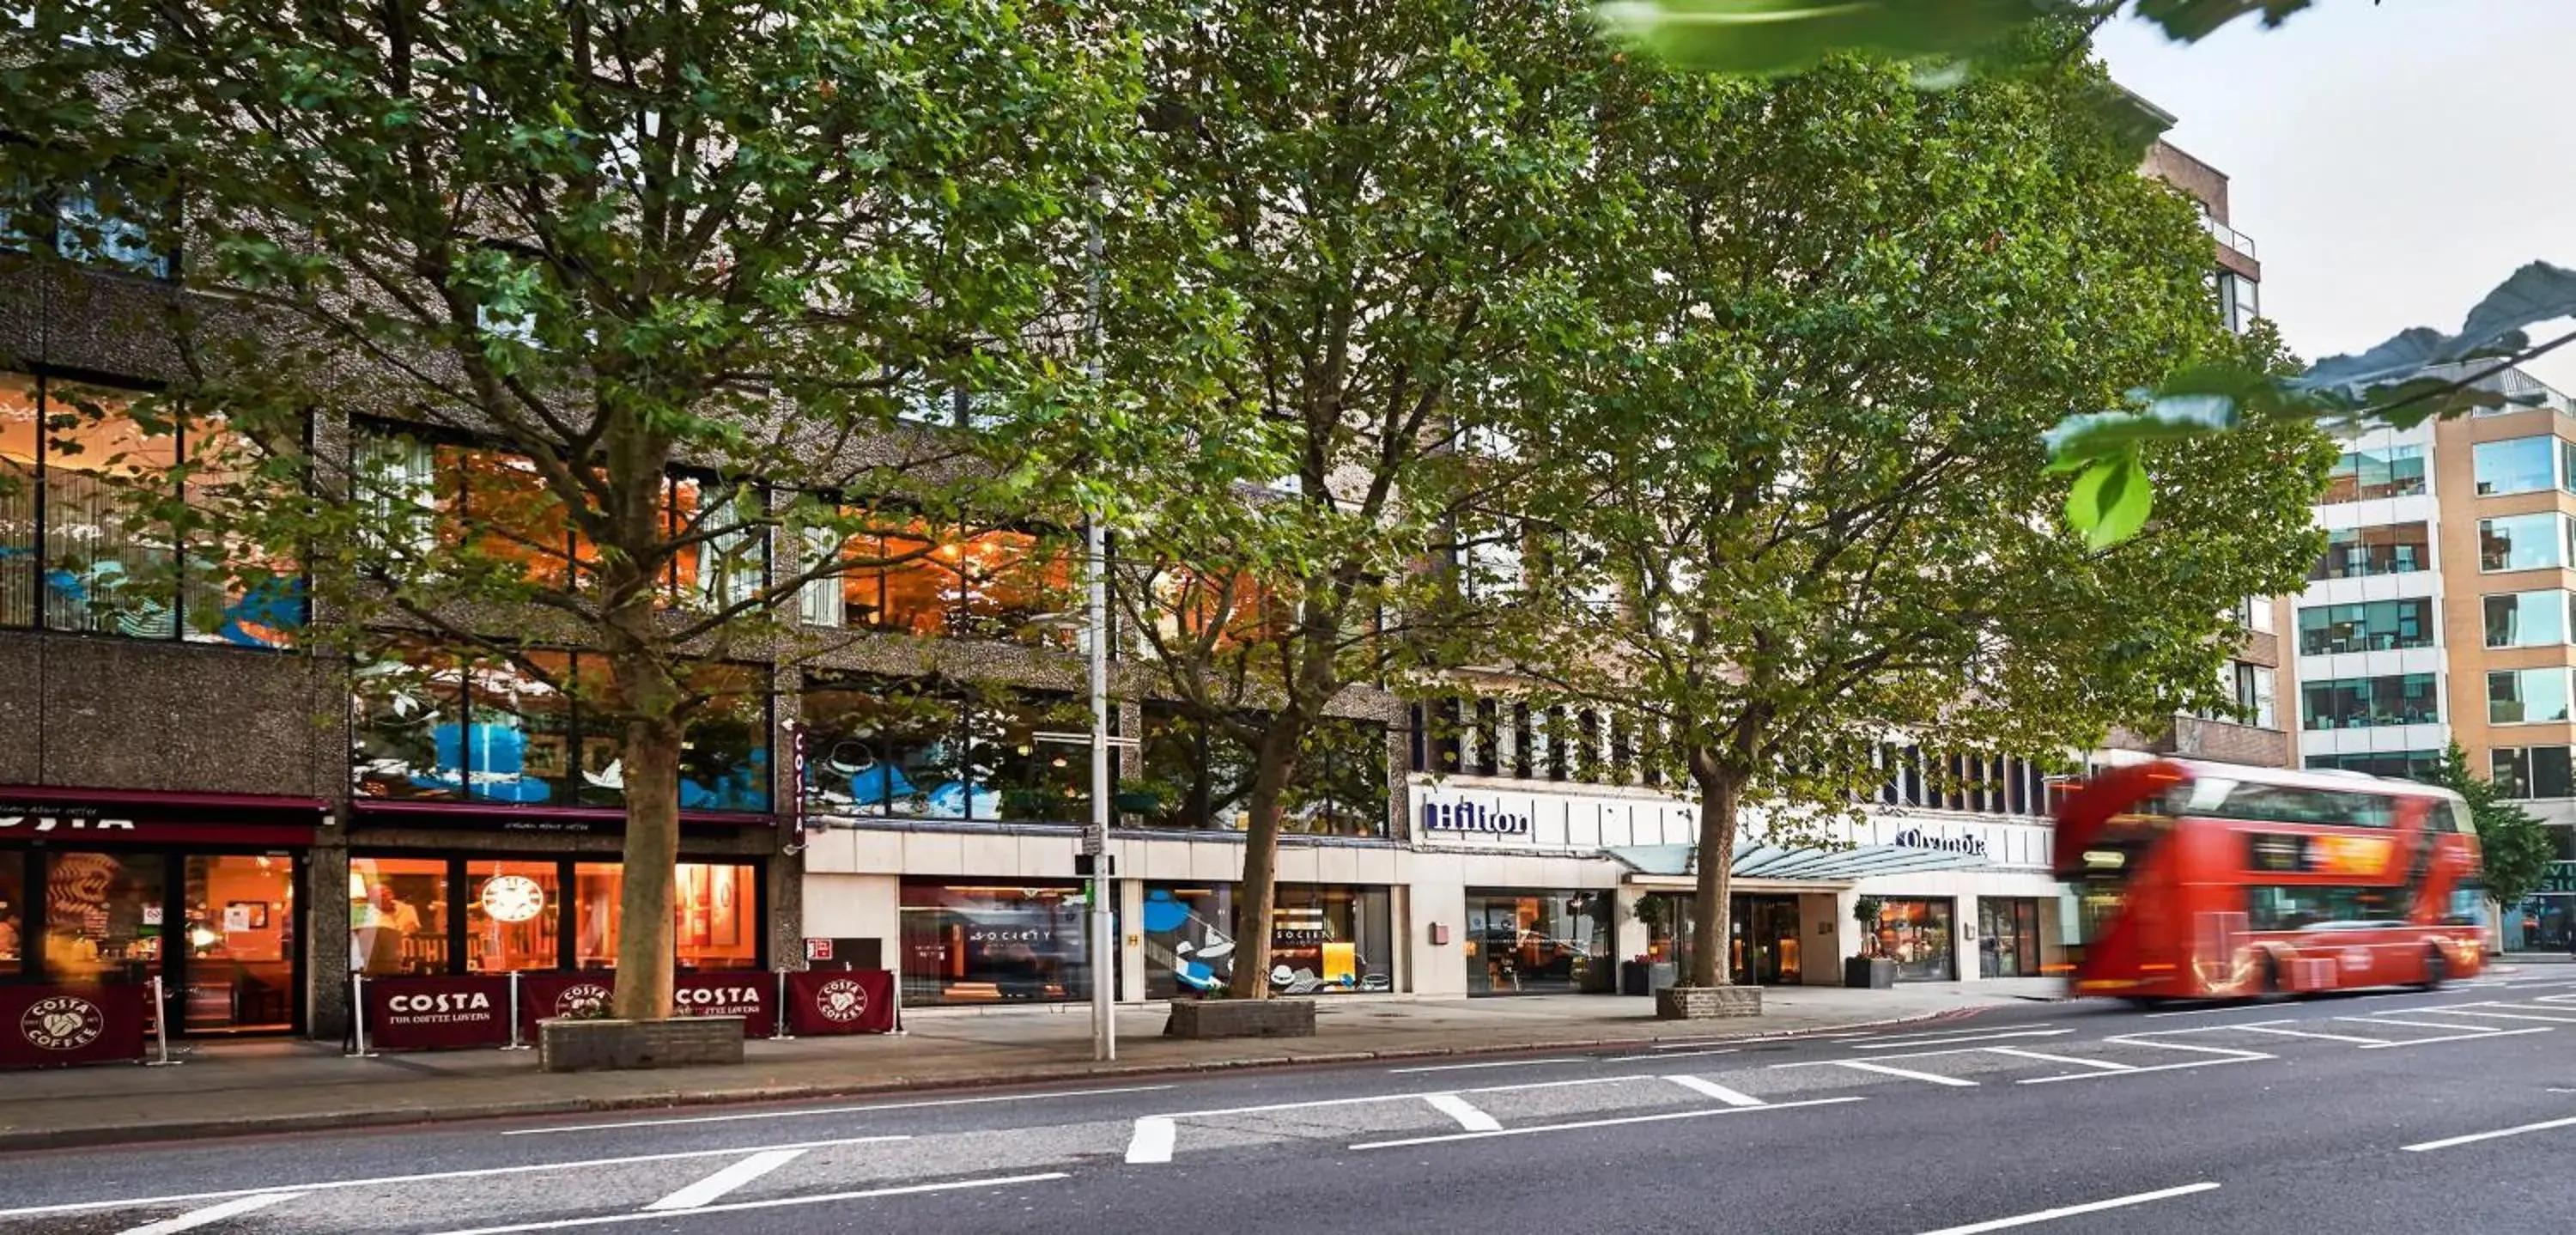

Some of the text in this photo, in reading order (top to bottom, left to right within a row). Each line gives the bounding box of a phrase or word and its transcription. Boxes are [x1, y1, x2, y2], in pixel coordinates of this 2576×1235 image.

[1429, 801, 1528, 833] Hilton
[975, 932, 1049, 940] SOCIETY
[564, 987, 605, 1000] COSTA
[676, 988, 759, 1005] COSTA
[823, 983, 859, 994] COSTA
[33, 1000, 88, 1016] COSTA
[389, 993, 489, 1012] COSTA
[29, 1029, 97, 1047] COFFEE
